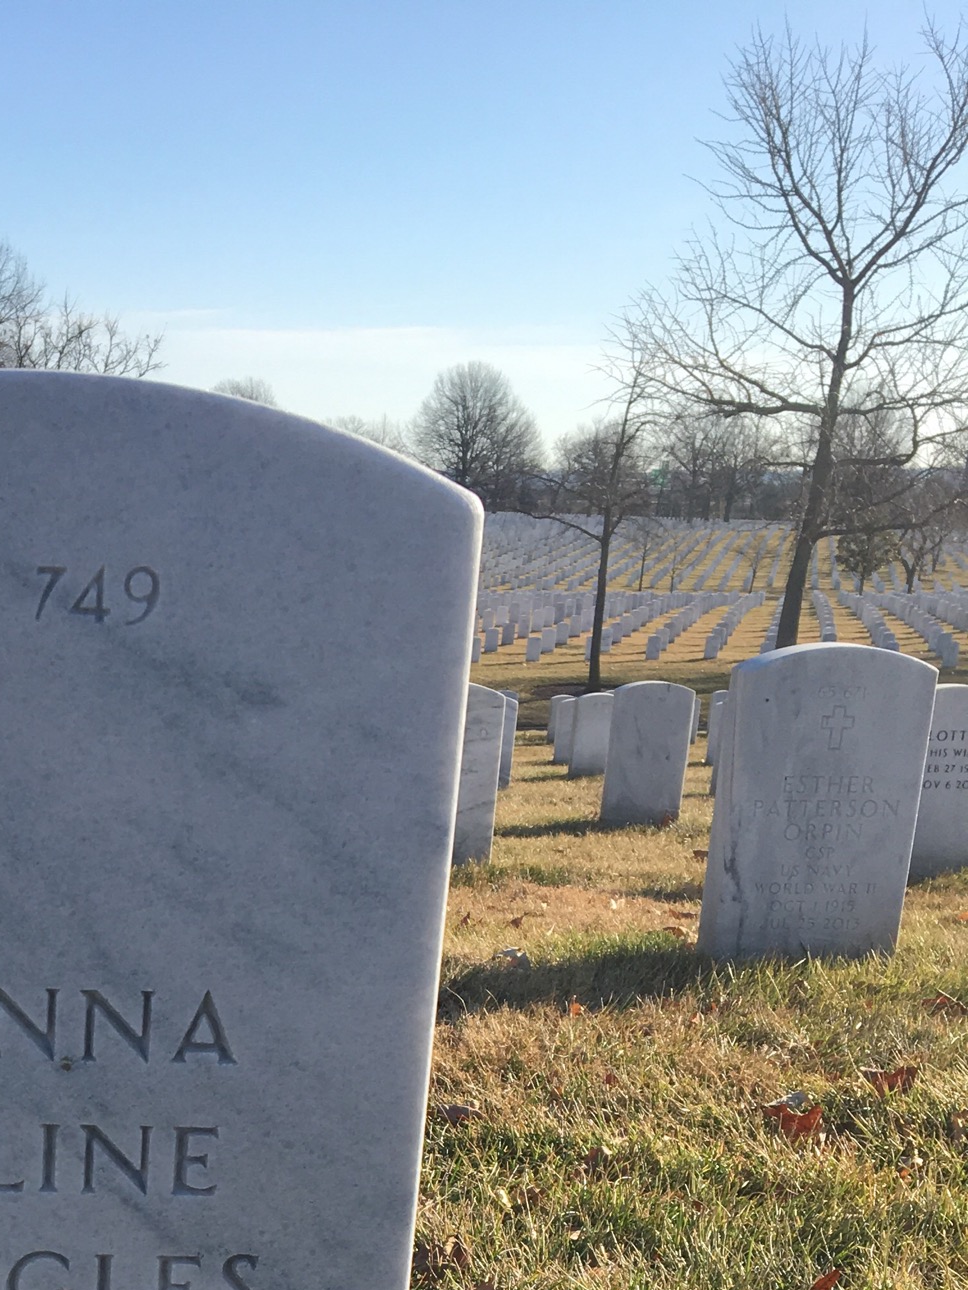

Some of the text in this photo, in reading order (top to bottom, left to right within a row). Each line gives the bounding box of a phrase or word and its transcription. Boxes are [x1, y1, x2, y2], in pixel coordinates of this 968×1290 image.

[35, 565, 161, 625] 749
[929, 730, 968, 741] LOTT
[953, 748, 968, 757] WI
[927, 764, 968, 773] EB 27 19
[783, 775, 874, 794] ESTHER
[922, 779, 968, 789] OV 6 20
[753, 799, 900, 818] PATTERSON
[783, 822, 863, 841] ORPIN
[781, 864, 854, 878] US NAVY
[754, 882, 878, 895] WORLD WAR II
[770, 900, 805, 913] OCT
[759, 917, 790, 930] JUL
